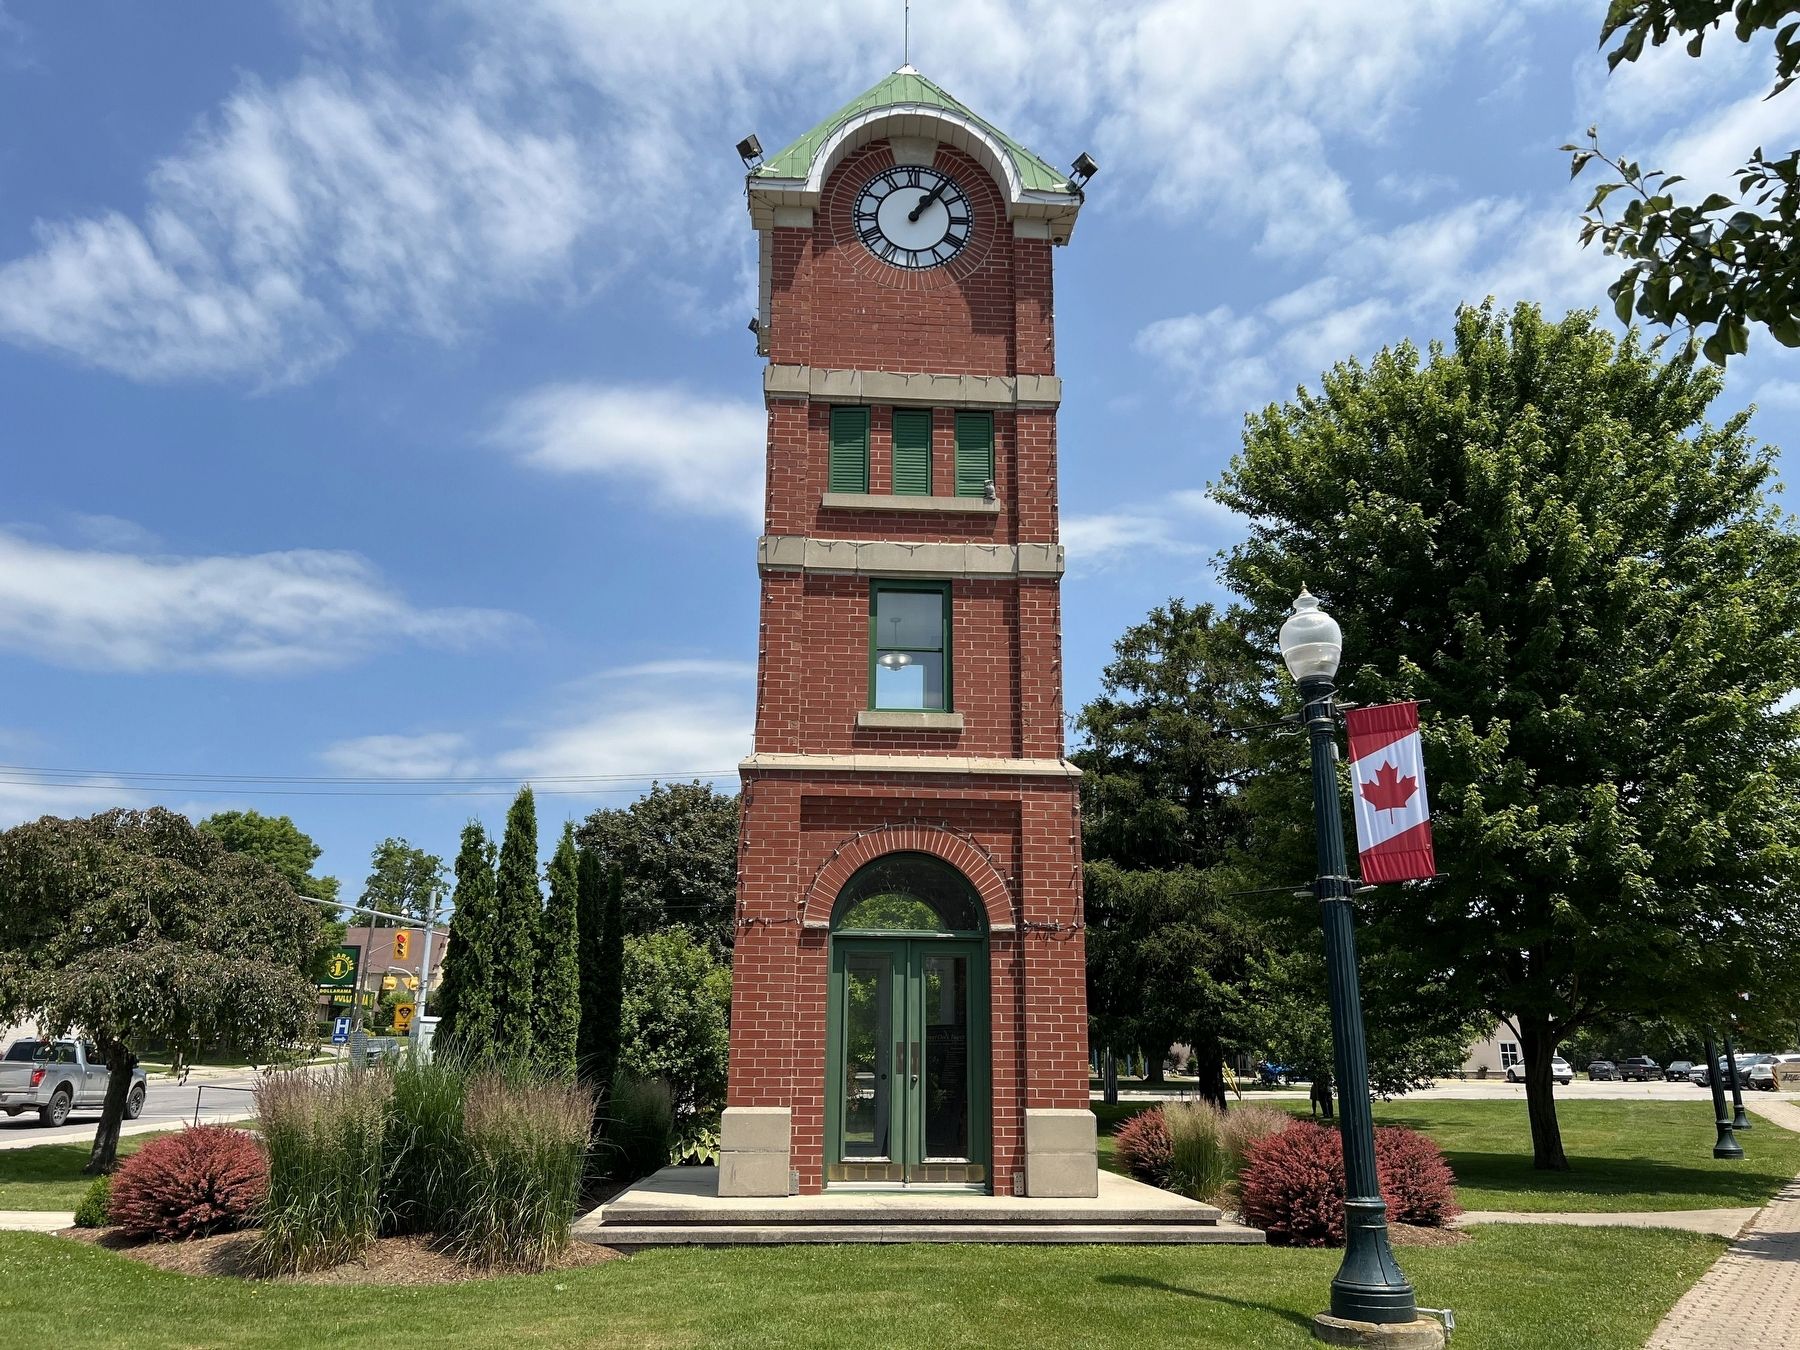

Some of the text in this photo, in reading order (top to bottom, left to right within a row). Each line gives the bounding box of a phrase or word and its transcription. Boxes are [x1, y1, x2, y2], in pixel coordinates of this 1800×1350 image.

[881, 174, 899, 191] XI
[906, 170, 921, 188] XII
[862, 188, 883, 203] X
[943, 195, 963, 206] II
[858, 211, 877, 221] IX
[949, 216, 968, 225] III
[906, 250, 919, 267] VI
[931, 248, 946, 263] V
[335, 1019, 349, 1034] H
